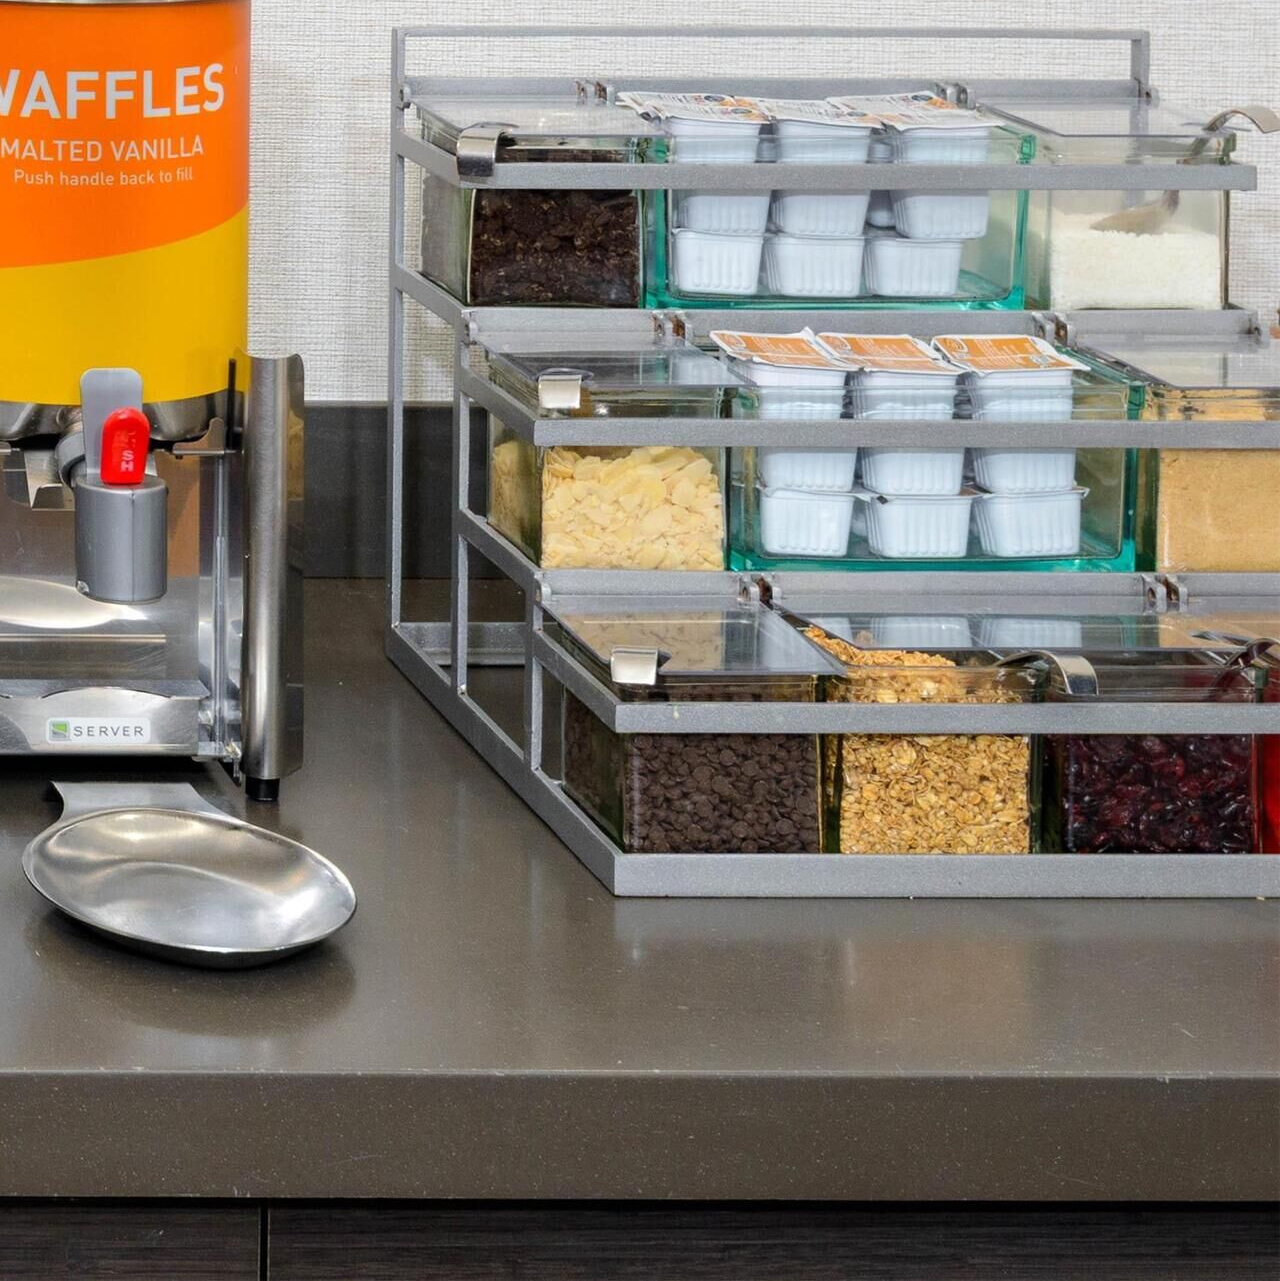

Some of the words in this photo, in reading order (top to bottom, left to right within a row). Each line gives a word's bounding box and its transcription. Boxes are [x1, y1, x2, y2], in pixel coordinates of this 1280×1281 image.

[1, 137, 103, 162] MALTED
[111, 134, 204, 162] VANILLA
[14, 169, 54, 185] Push
[60, 171, 114, 186] handle
[120, 170, 155, 185] back
[159, 170, 173, 183] to
[176, 166, 193, 181] fill
[73, 725, 145, 737] SERVER
